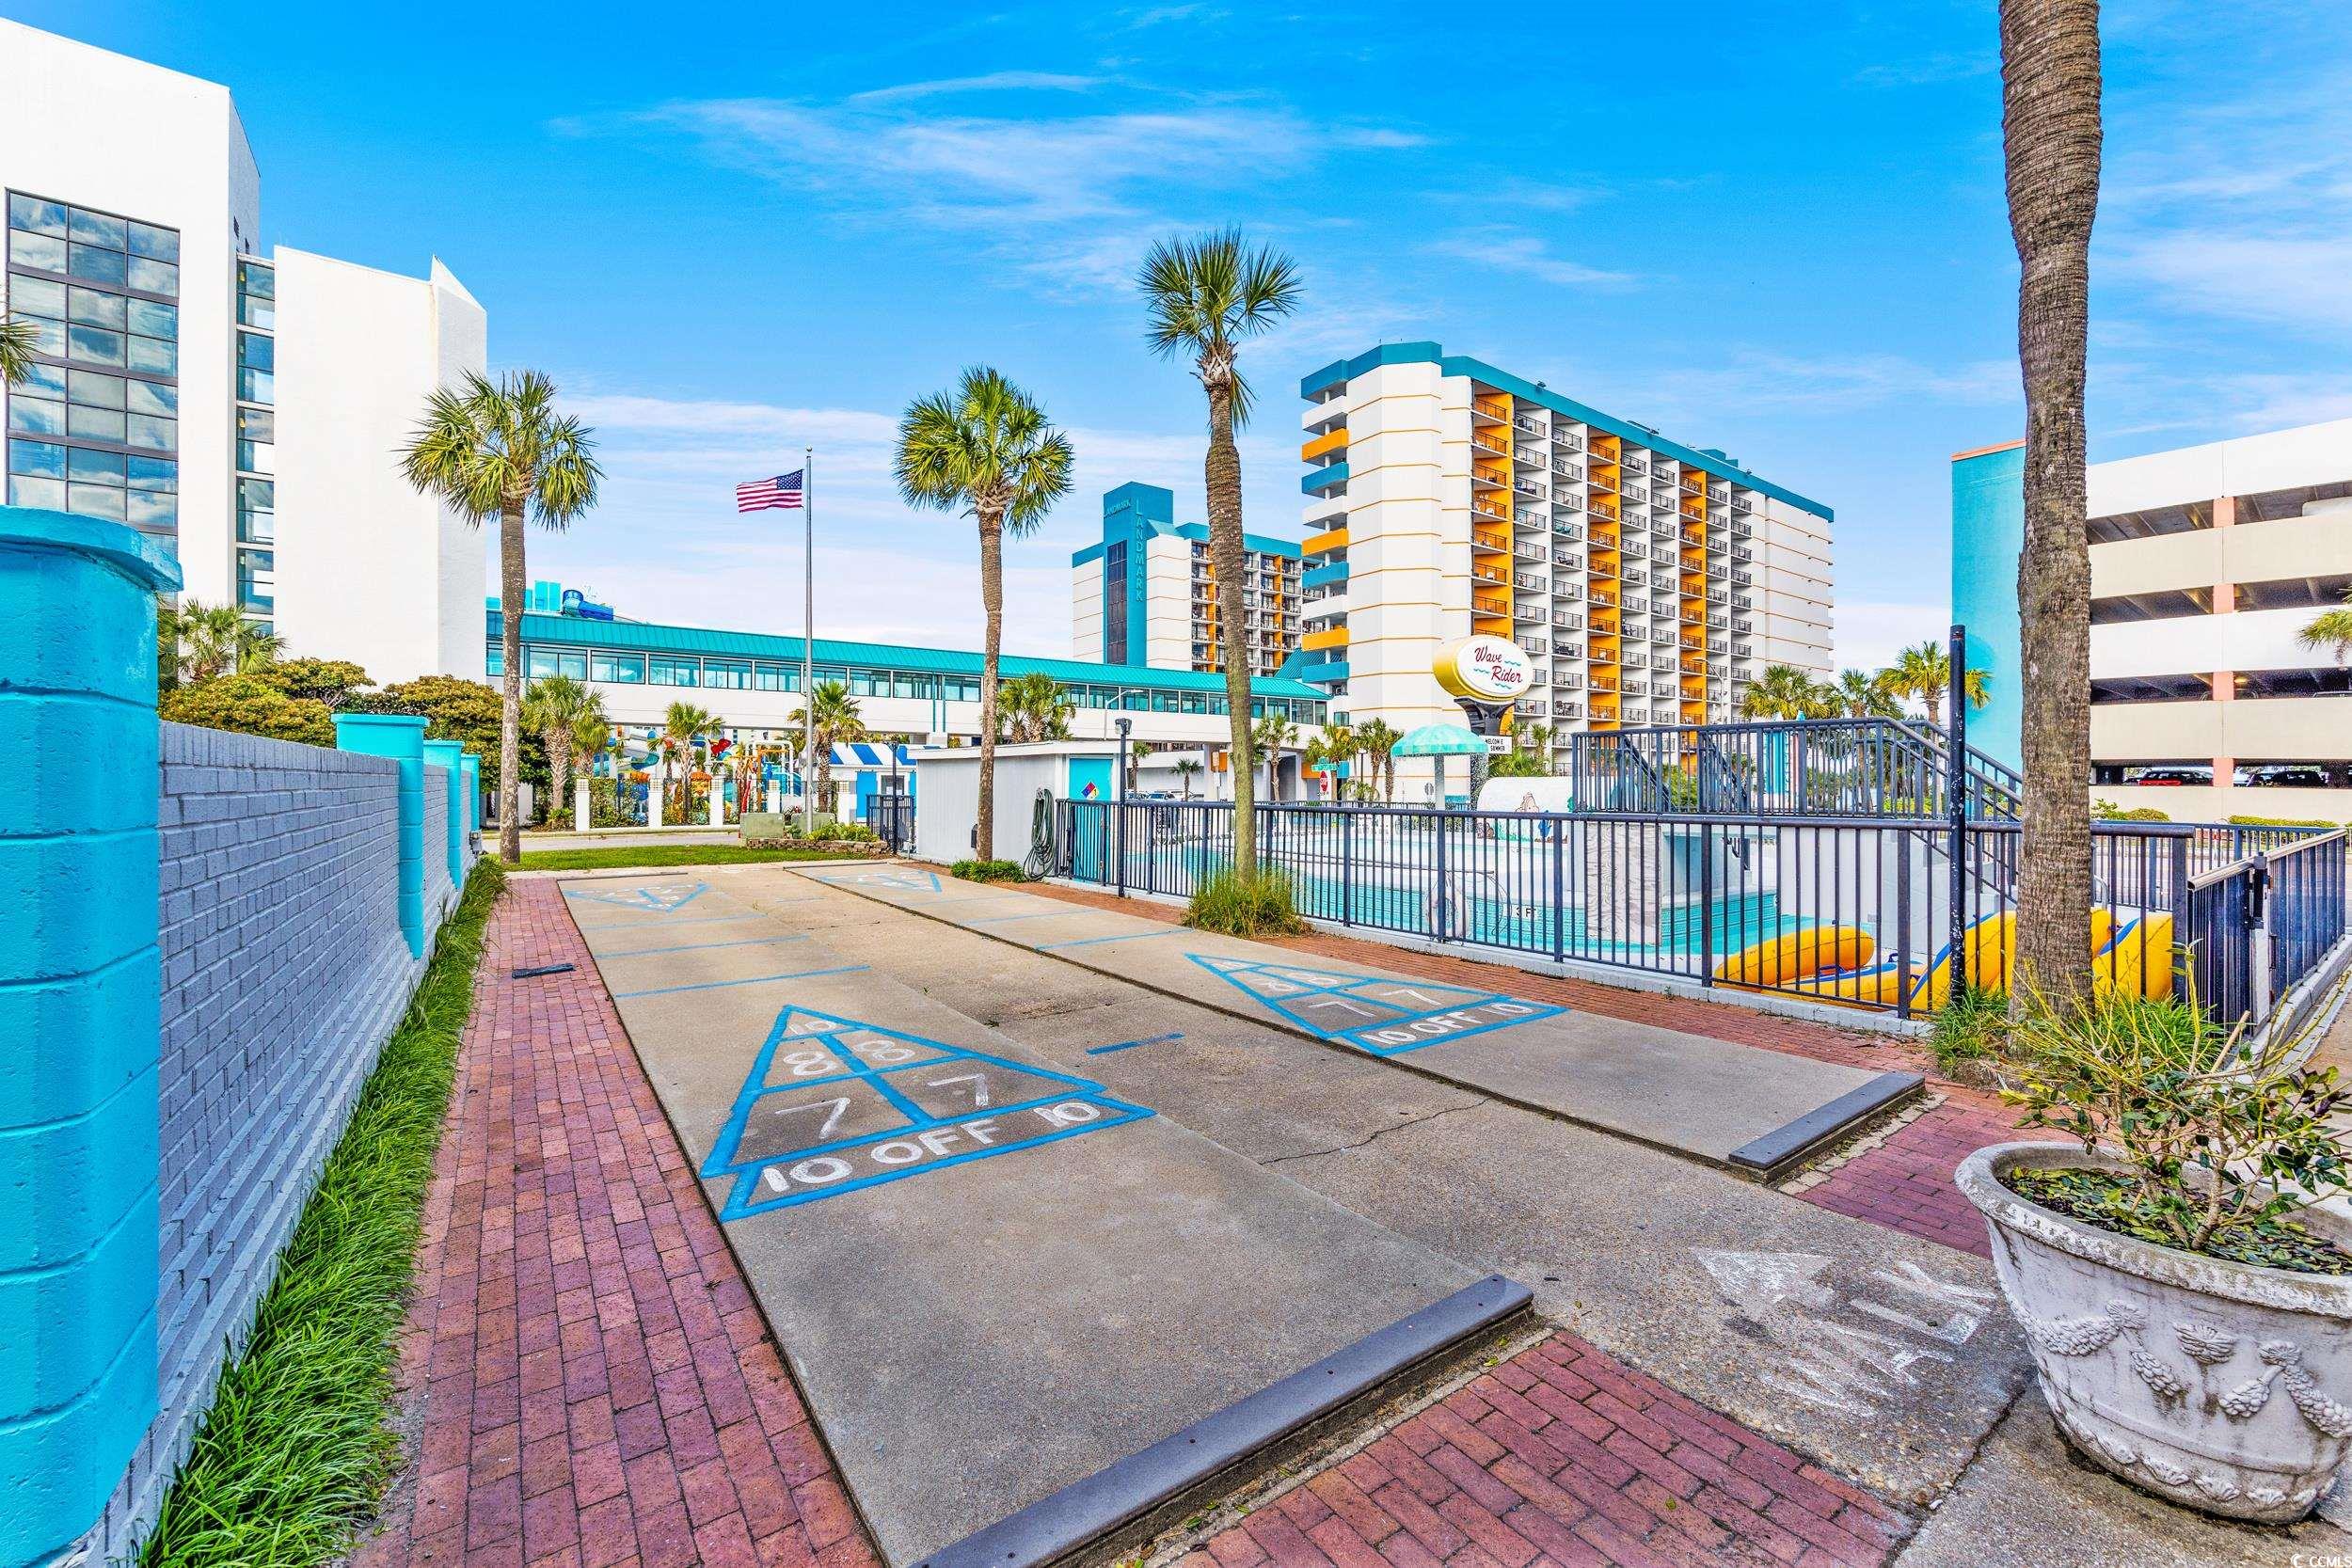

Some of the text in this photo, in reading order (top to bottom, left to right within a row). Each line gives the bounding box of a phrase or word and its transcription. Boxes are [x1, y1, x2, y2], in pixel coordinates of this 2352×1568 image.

[1136, 499, 1144, 602] LANDMARK
[1474, 645, 1502, 663] Wave
[1491, 665, 1523, 684] Rider
[1308, 989, 1441, 1017] 7 7
[787, 1019, 837, 1036] 10
[1361, 1003, 1534, 1045] 10 OFF 10
[783, 1040, 915, 1076] 8 8
[775, 1072, 991, 1140] 7 7
[763, 1101, 1102, 1192] 10 OFF 10
